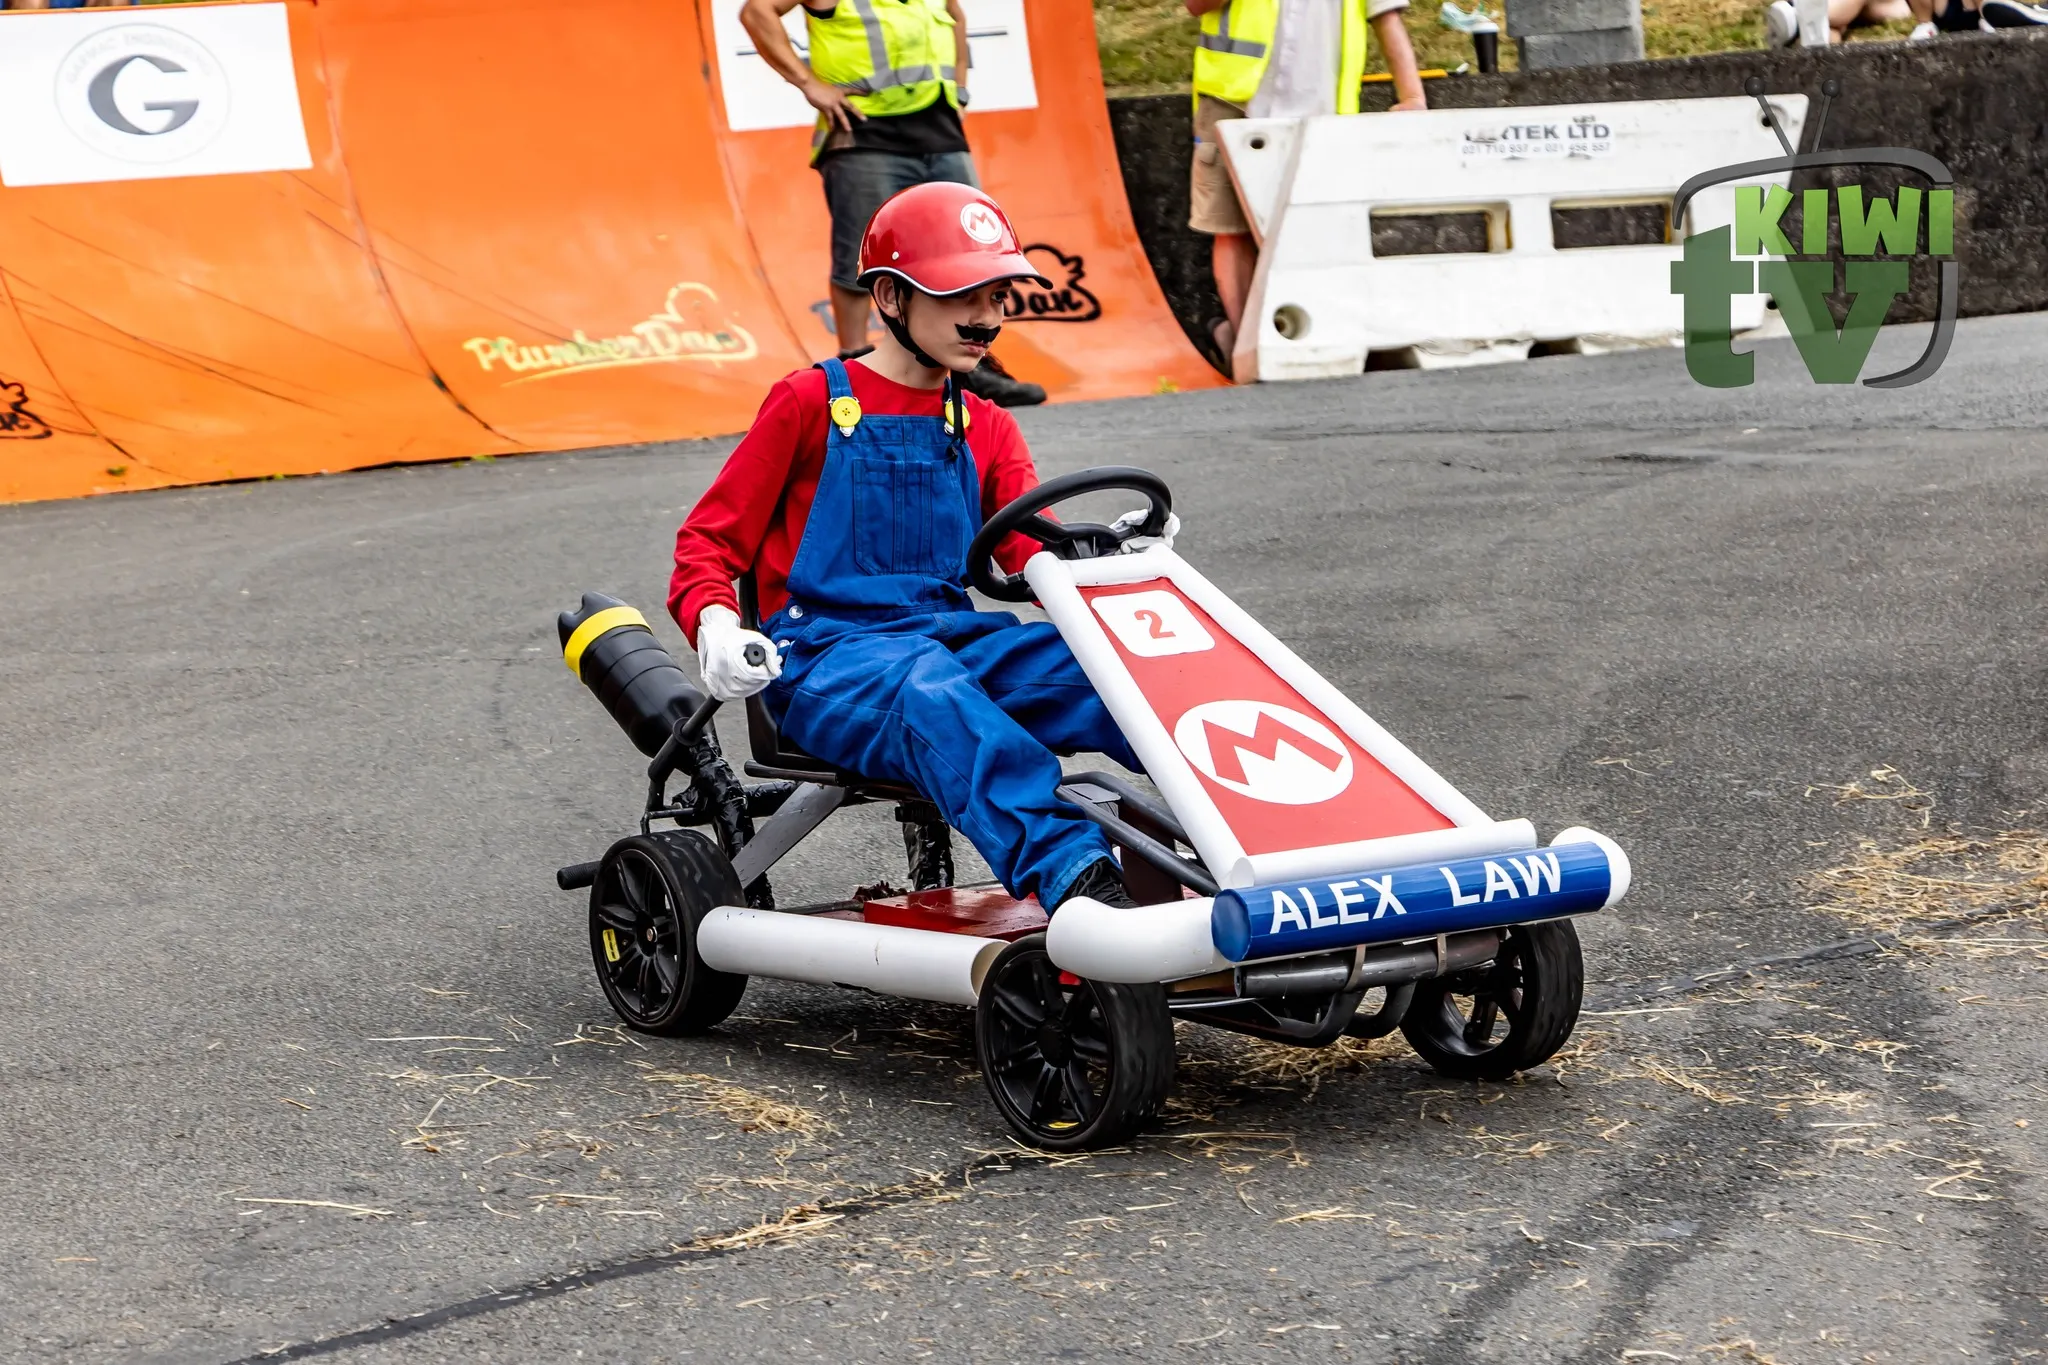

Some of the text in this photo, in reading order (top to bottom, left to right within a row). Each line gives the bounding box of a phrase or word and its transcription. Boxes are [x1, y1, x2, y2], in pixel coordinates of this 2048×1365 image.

[87, 53, 200, 136] G
[1567, 123, 1610, 139] LTD
[969, 211, 997, 232] M
[1133, 609, 1177, 639] 2
[1202, 711, 1343, 786] M
[1269, 853, 1562, 934] ALEX LAW
